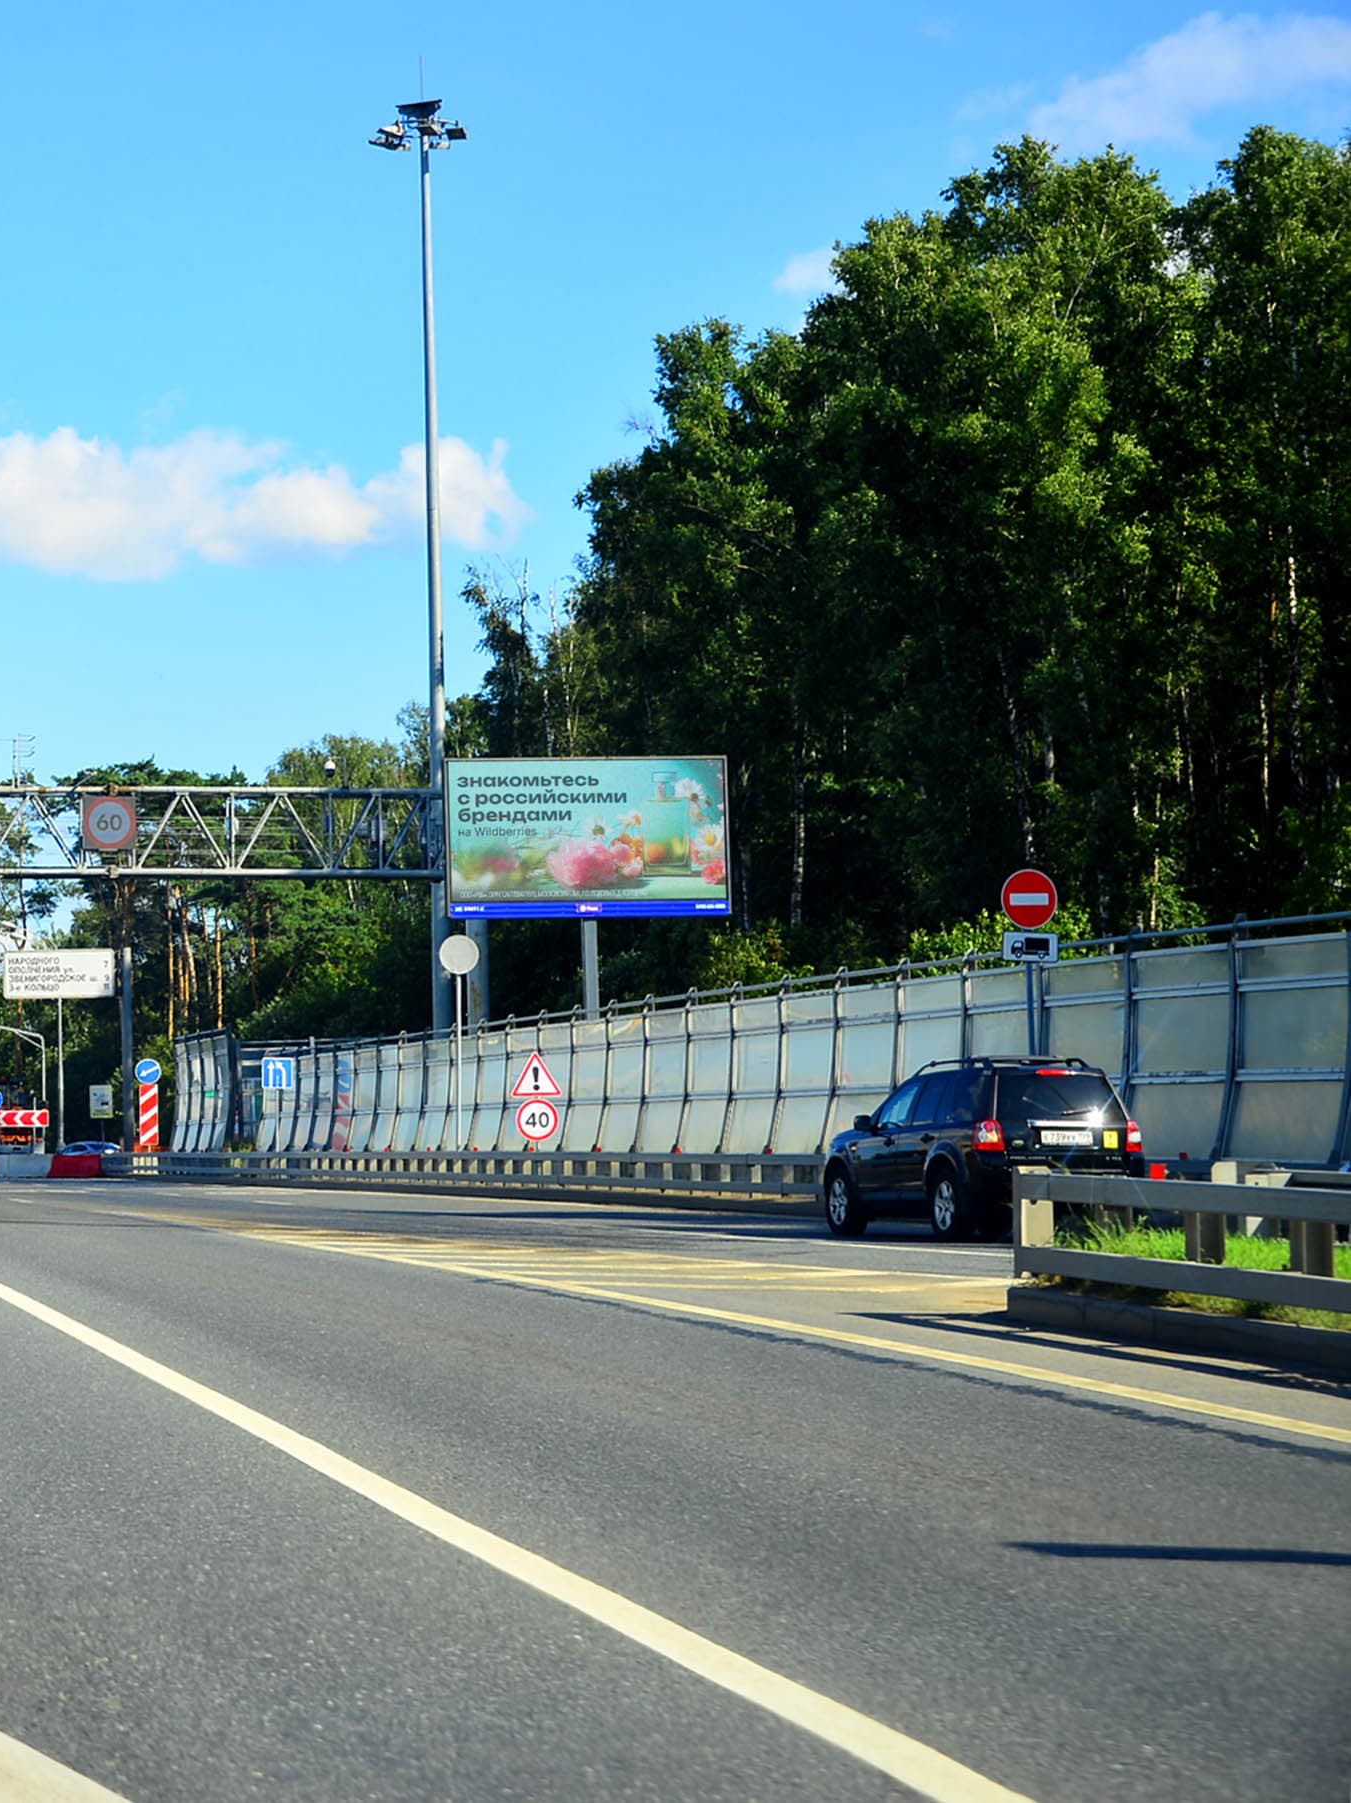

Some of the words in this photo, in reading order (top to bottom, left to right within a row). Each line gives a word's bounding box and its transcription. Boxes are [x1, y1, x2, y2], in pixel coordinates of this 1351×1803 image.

[457, 774, 599, 788] знакомьтесь
[457, 794, 470, 805] с
[474, 788, 627, 808] российскими
[96, 813, 123, 831] 60
[457, 807, 572, 825] брендами
[457, 828, 472, 837] на
[474, 826, 538, 837] Wildberries
[7, 957, 60, 965] НАРОДНОГО
[8, 966, 61, 974] ОПОЛЧЕНИЯ
[24, 983, 60, 993] КОЛЬЦО
[524, 1111, 550, 1128] 40
